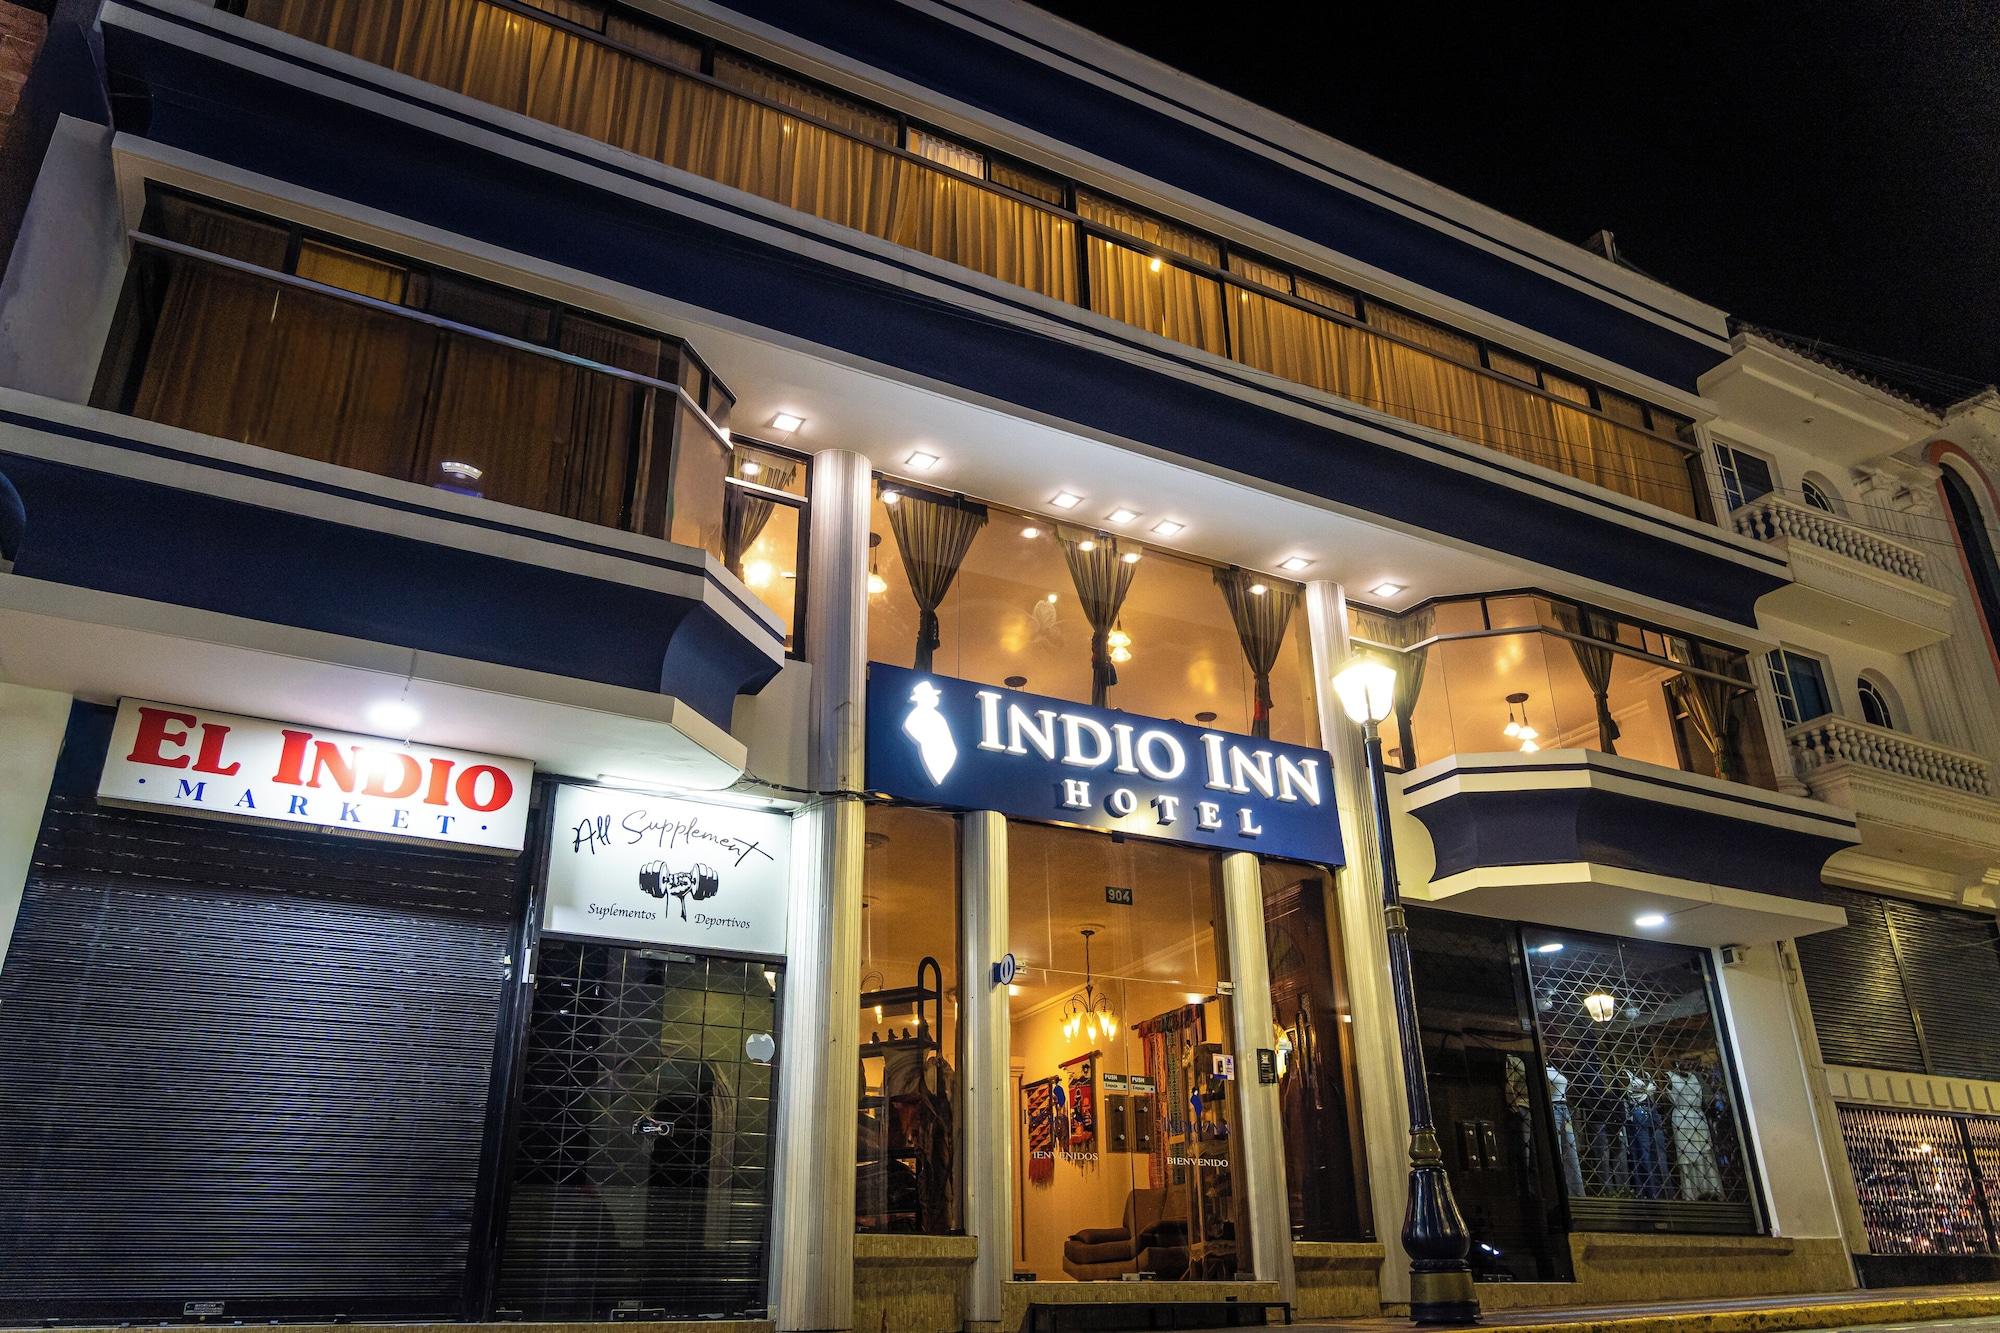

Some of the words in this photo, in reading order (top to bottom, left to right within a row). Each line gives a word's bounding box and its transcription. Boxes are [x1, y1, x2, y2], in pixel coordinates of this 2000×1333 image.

[126, 706, 241, 776] EL
[272, 729, 514, 812] INDIO
[975, 690, 1186, 781] INDIO
[1200, 733, 1319, 807] INN
[175, 778, 456, 835] MARKET
[1060, 778, 1262, 837] HOTEL
[572, 814, 612, 855] All
[621, 809, 774, 868] Supplement
[587, 903, 657, 921] Suplementos
[694, 913, 751, 930] Deportivos
[1108, 889, 1131, 903] 904
